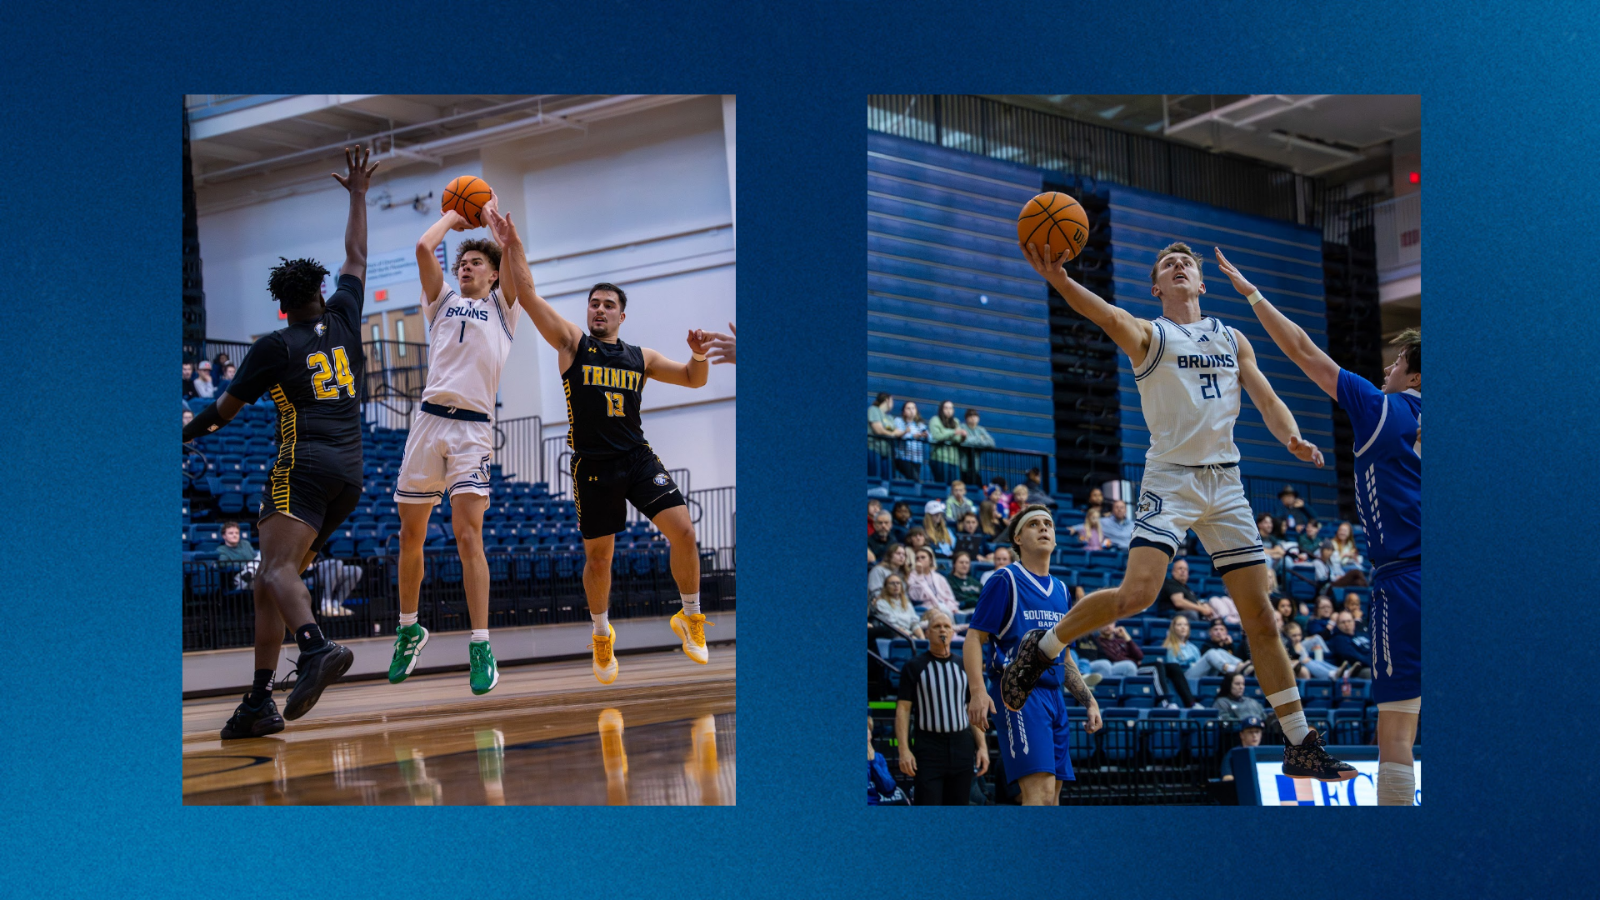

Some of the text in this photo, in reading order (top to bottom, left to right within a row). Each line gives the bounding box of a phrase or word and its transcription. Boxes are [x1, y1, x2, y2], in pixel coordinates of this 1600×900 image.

[445, 306, 488, 321] BRUINS
[459, 320, 466, 343] 1
[306, 345, 356, 400] 24
[1177, 354, 1235, 369] BRUINS
[582, 364, 642, 392] TRINITY
[1199, 373, 1221, 399] 21
[605, 391, 626, 417] 13
